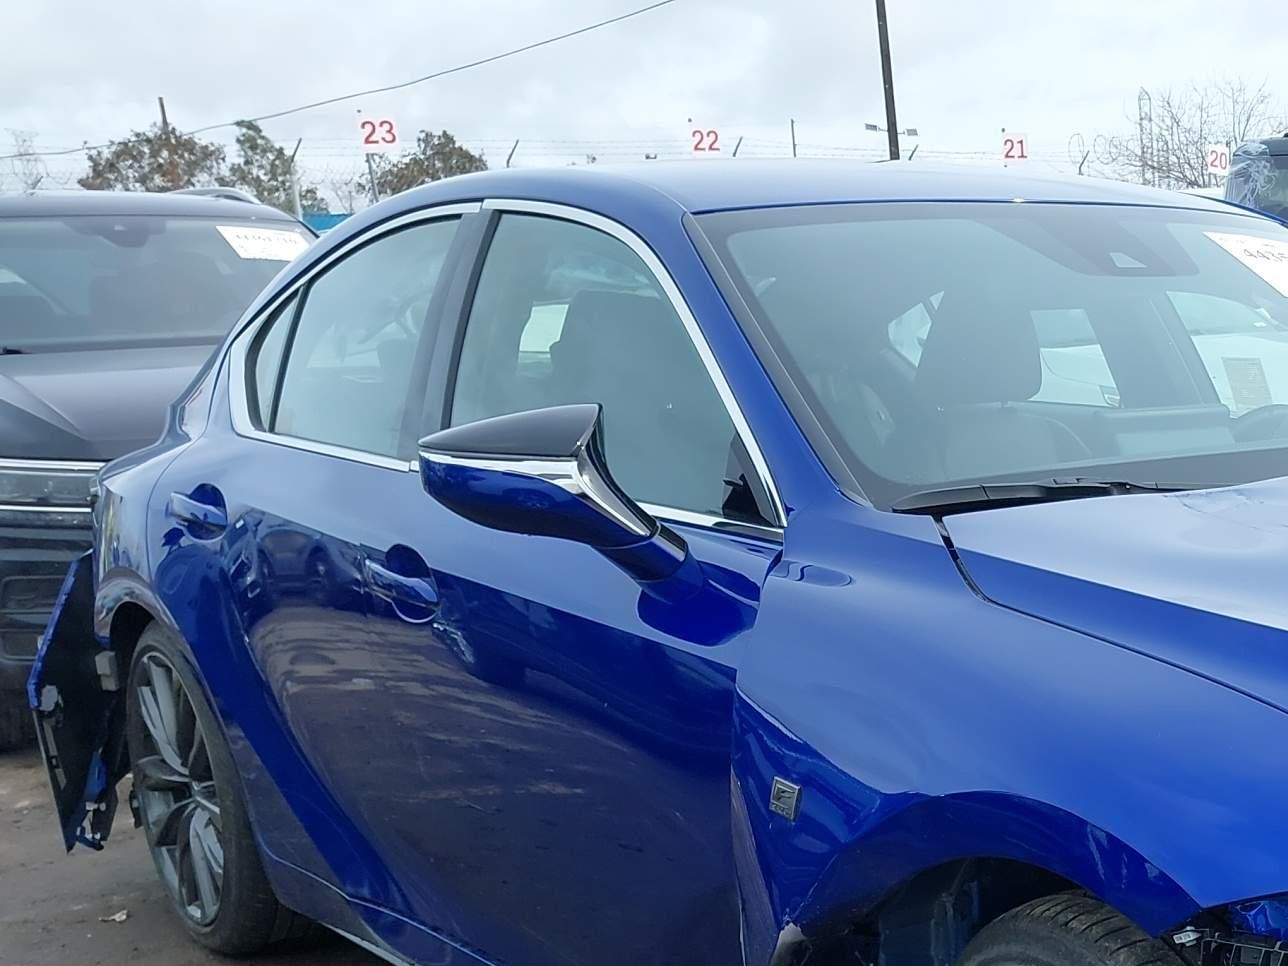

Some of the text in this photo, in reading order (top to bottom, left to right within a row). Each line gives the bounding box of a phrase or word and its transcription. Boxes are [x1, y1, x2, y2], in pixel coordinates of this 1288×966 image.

[360, 120, 397, 145] 23
[691, 129, 721, 152] 22
[1003, 138, 1028, 159] 21
[1209, 149, 1228, 170] 20
